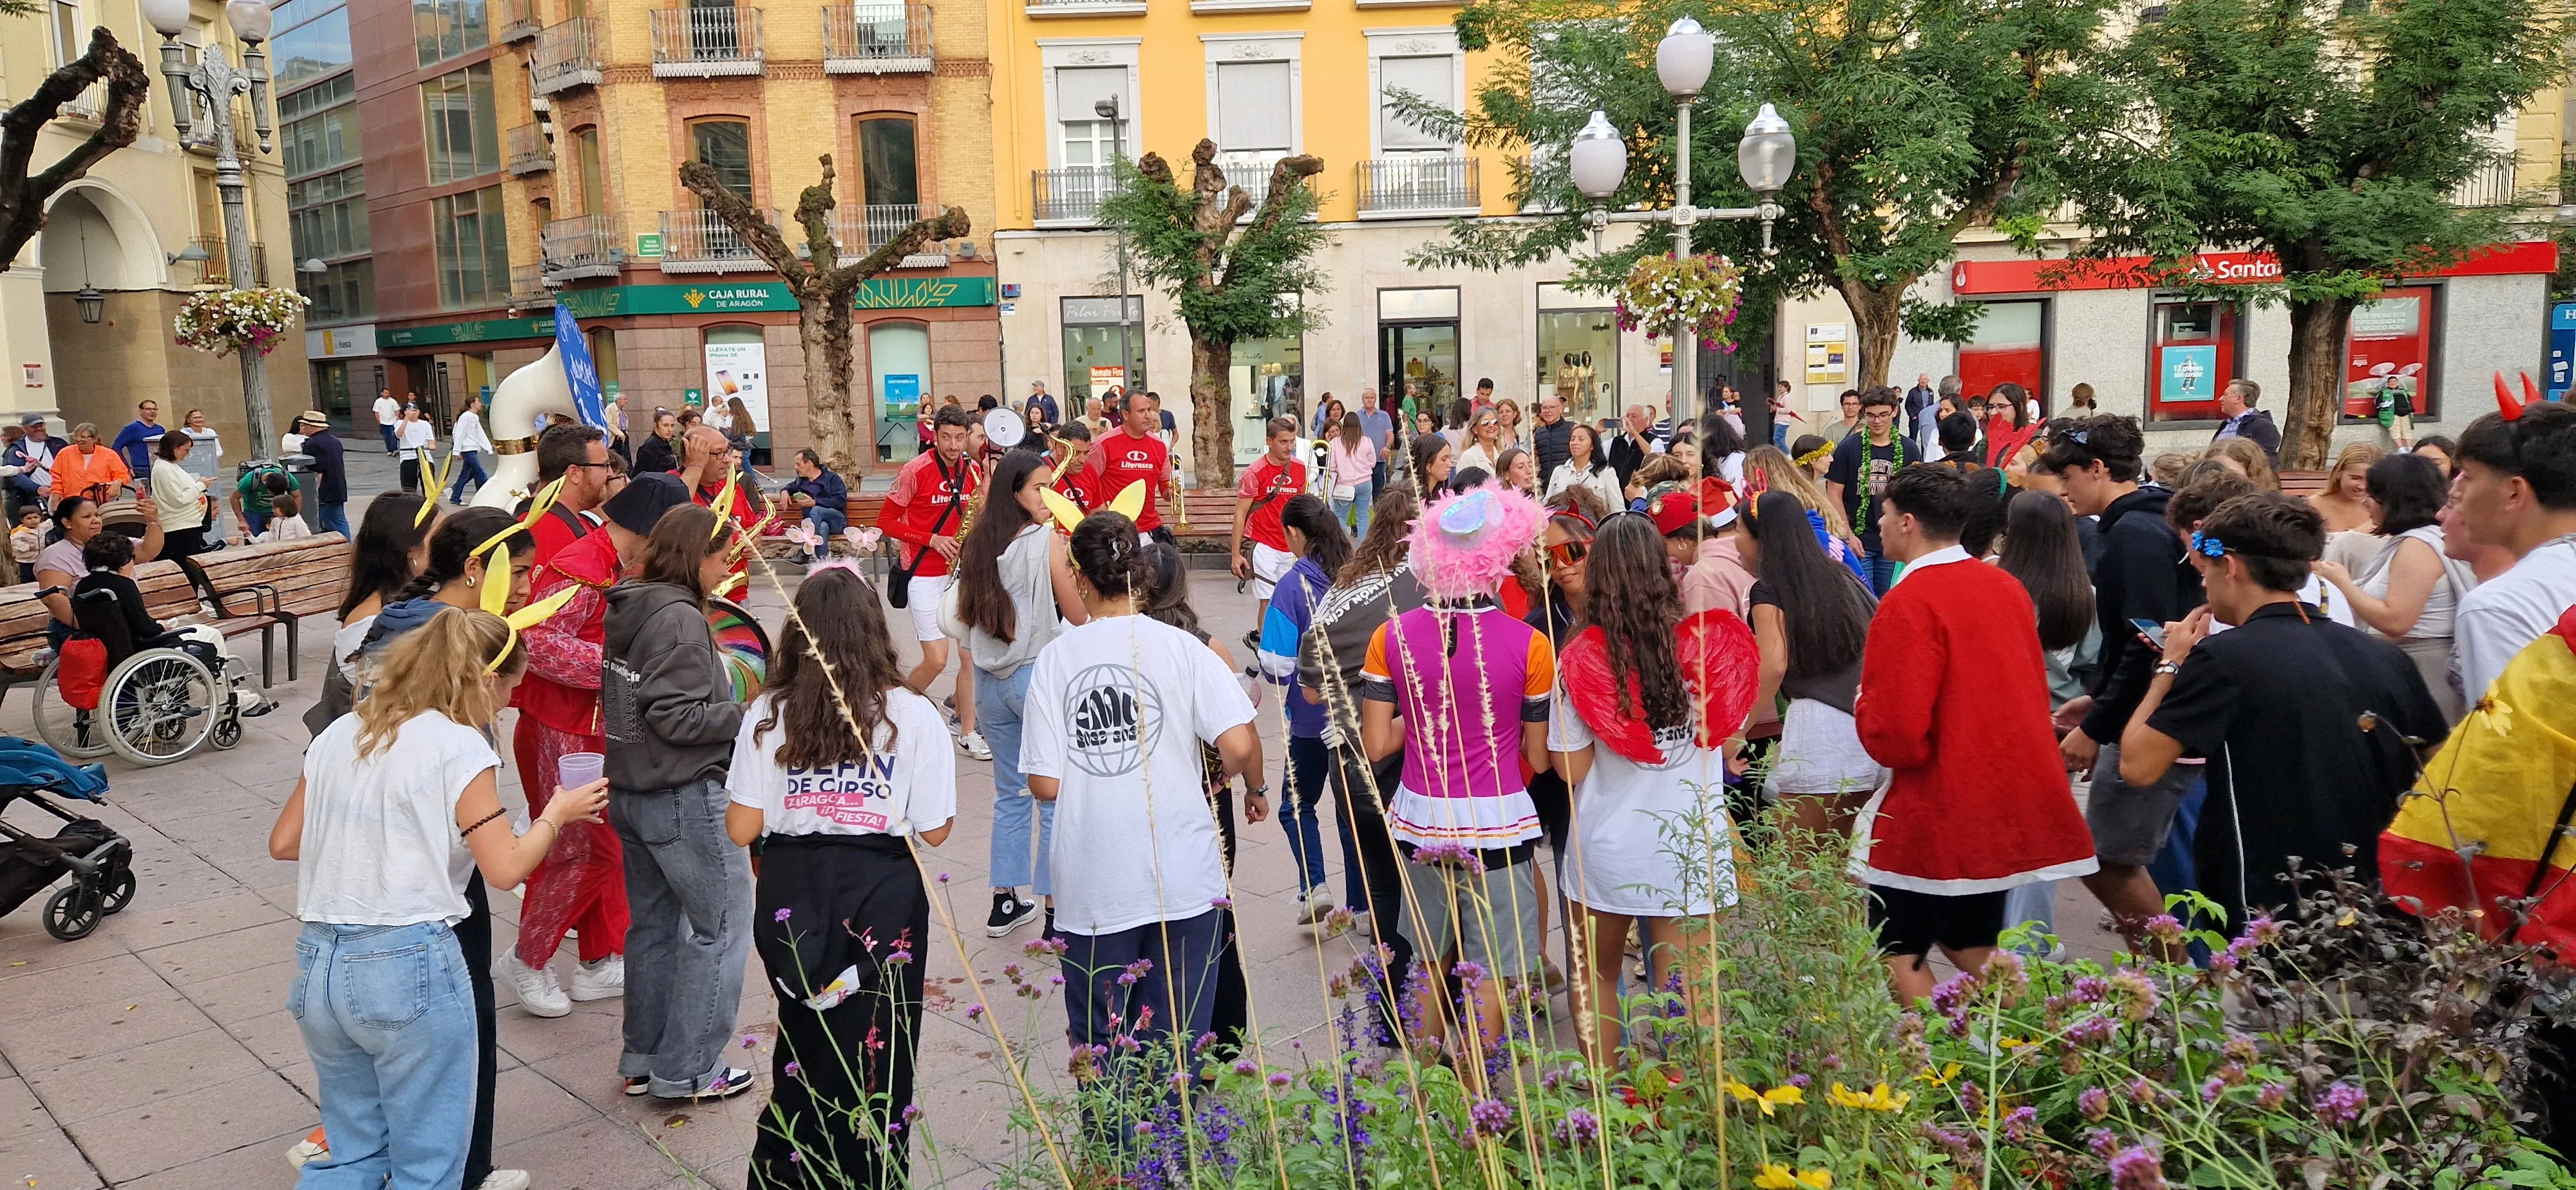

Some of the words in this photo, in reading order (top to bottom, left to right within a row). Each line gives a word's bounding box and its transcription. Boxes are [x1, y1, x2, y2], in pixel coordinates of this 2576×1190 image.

[708, 290, 734, 299] CAJA
[736, 289, 770, 298] RURAL
[729, 299, 763, 308] ARAGÓN
[1066, 305, 1098, 317] Pilar
[1102, 305, 1139, 317] Prito
[1092, 368, 1112, 377] Remate
[1112, 368, 1124, 376] Fina
[931, 494, 970, 504] Litersca
[1352, 575, 1393, 605] RAMÓN
[1324, 598, 1352, 626] ACÍN
[1113, 725, 1144, 744] 202
[788, 777, 812, 795] DE
[835, 812, 883, 827] FIESTA!
